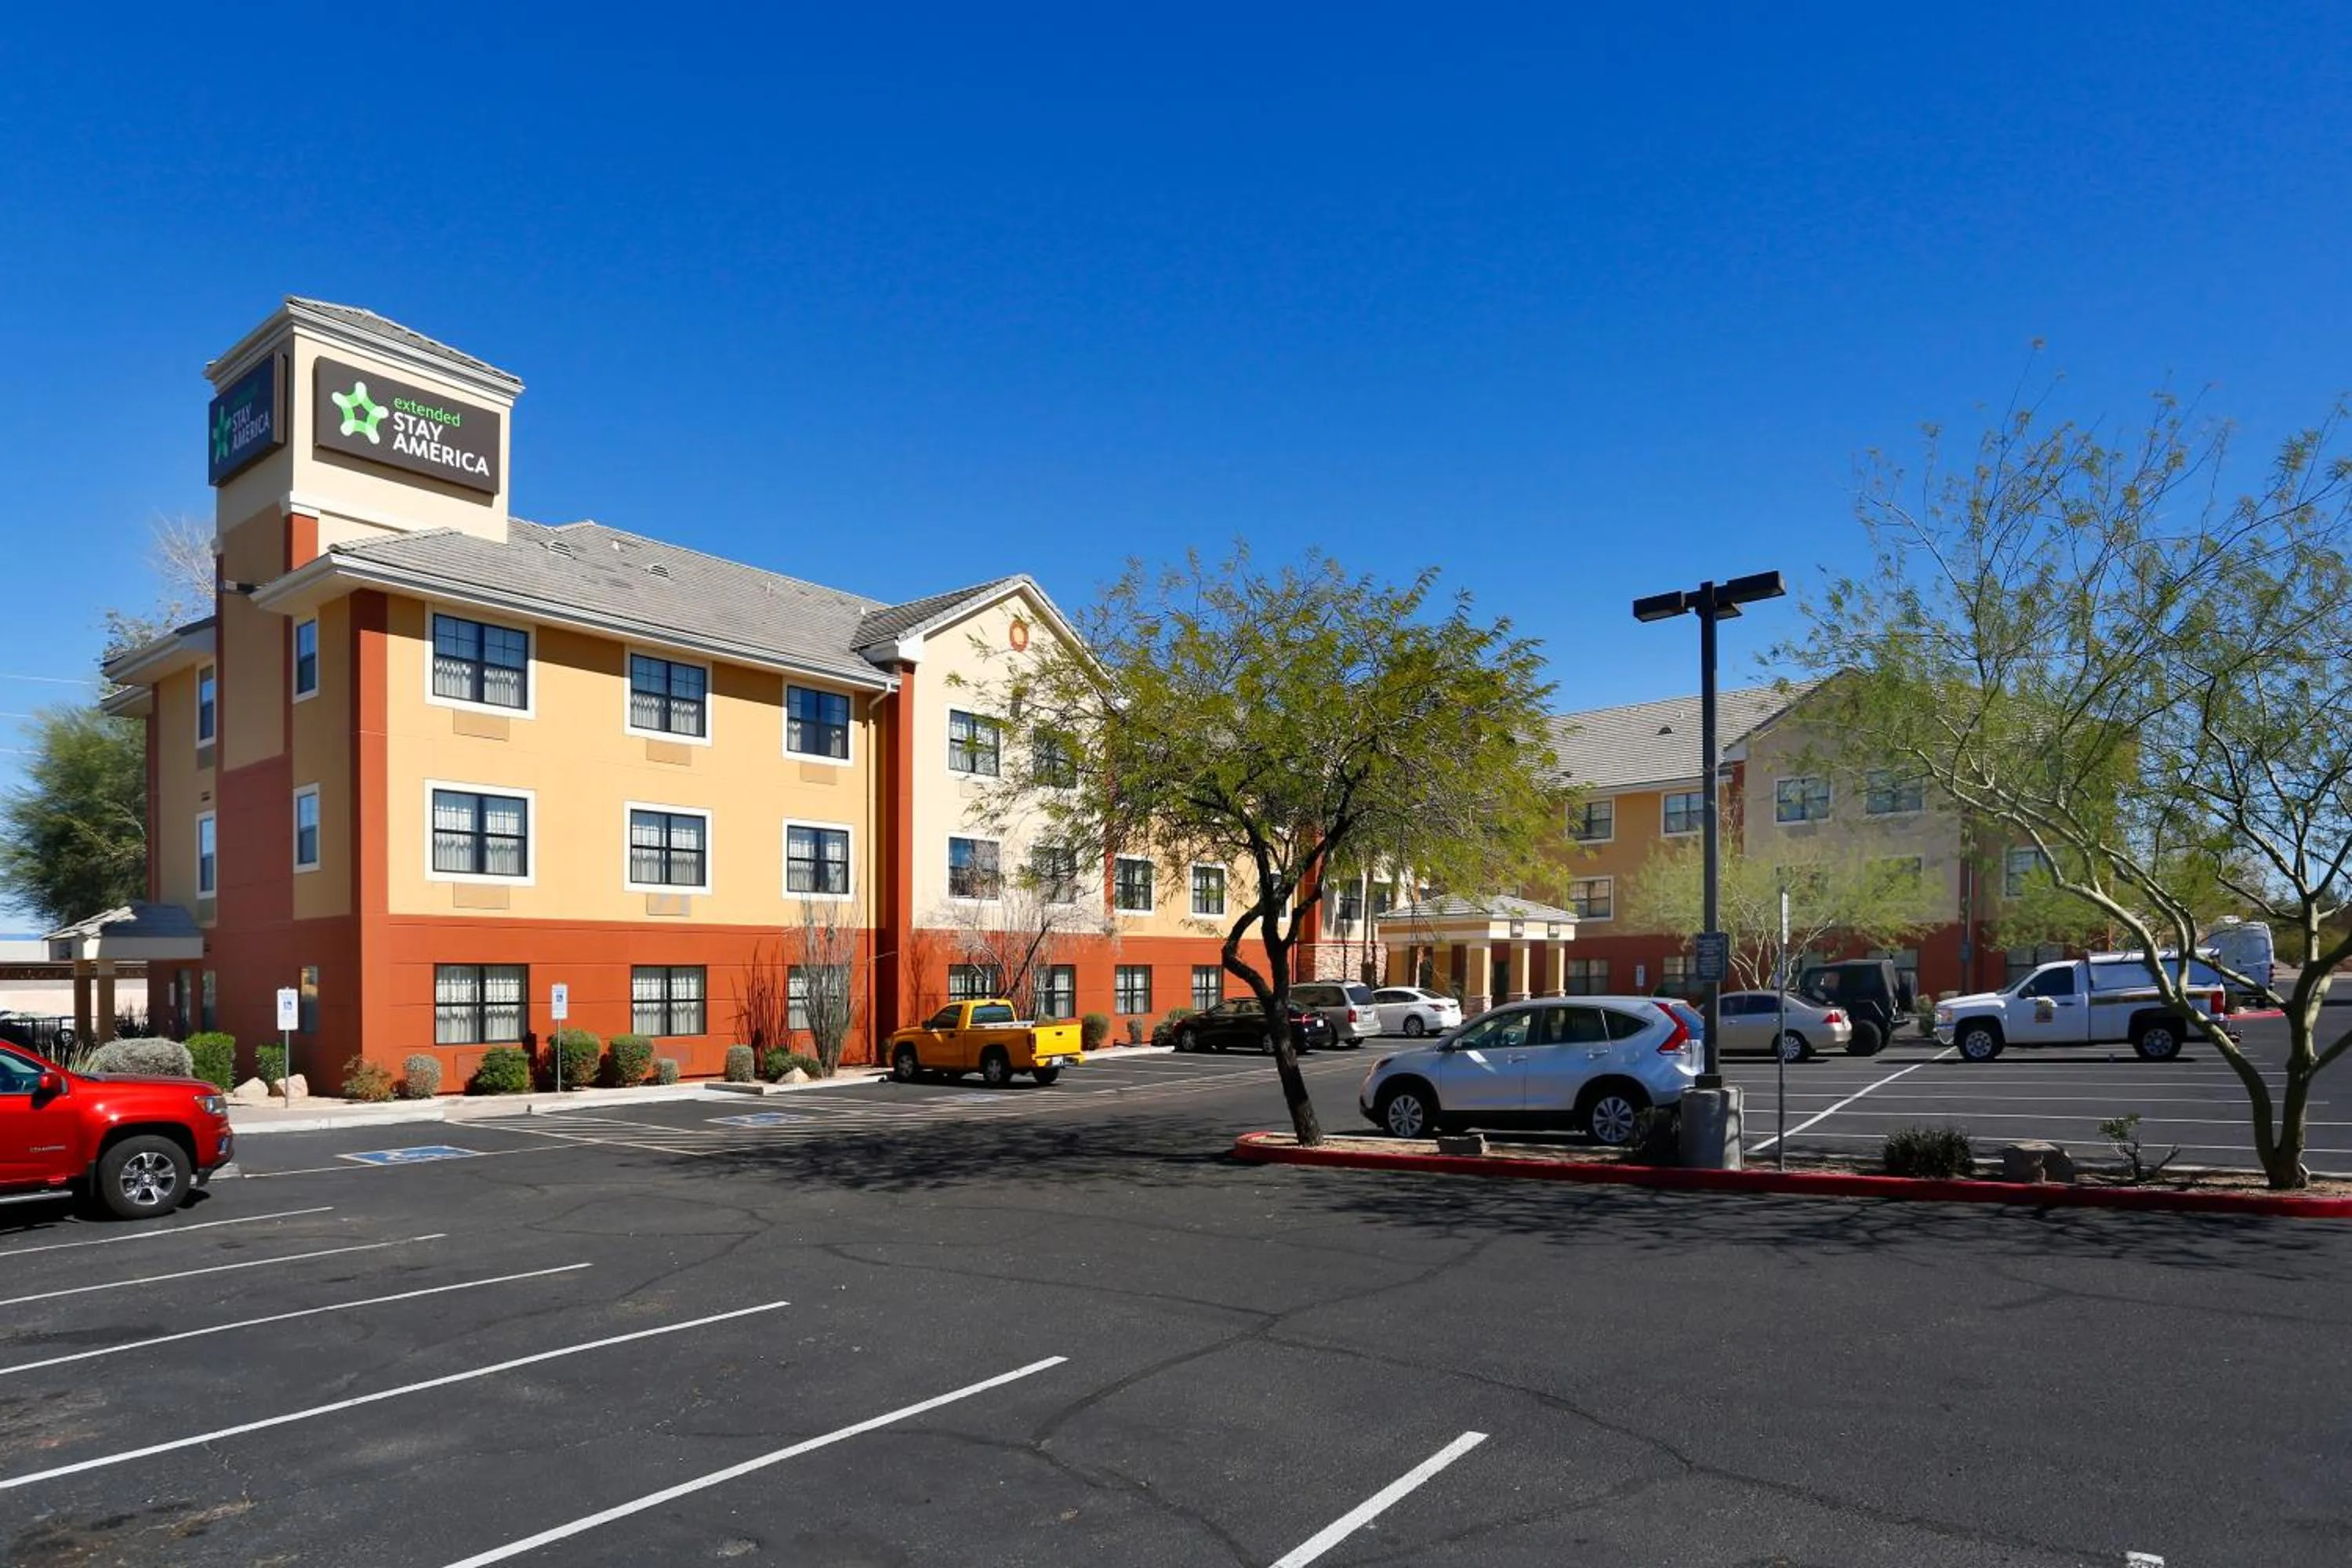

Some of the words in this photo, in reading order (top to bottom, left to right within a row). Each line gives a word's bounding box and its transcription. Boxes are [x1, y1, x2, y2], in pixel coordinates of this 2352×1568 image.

[232, 401, 252, 432] STAY
[394, 397, 460, 427] extended
[394, 412, 443, 441] STAY
[231, 410, 270, 452] AMERICA
[393, 432, 489, 477] AMERICA
